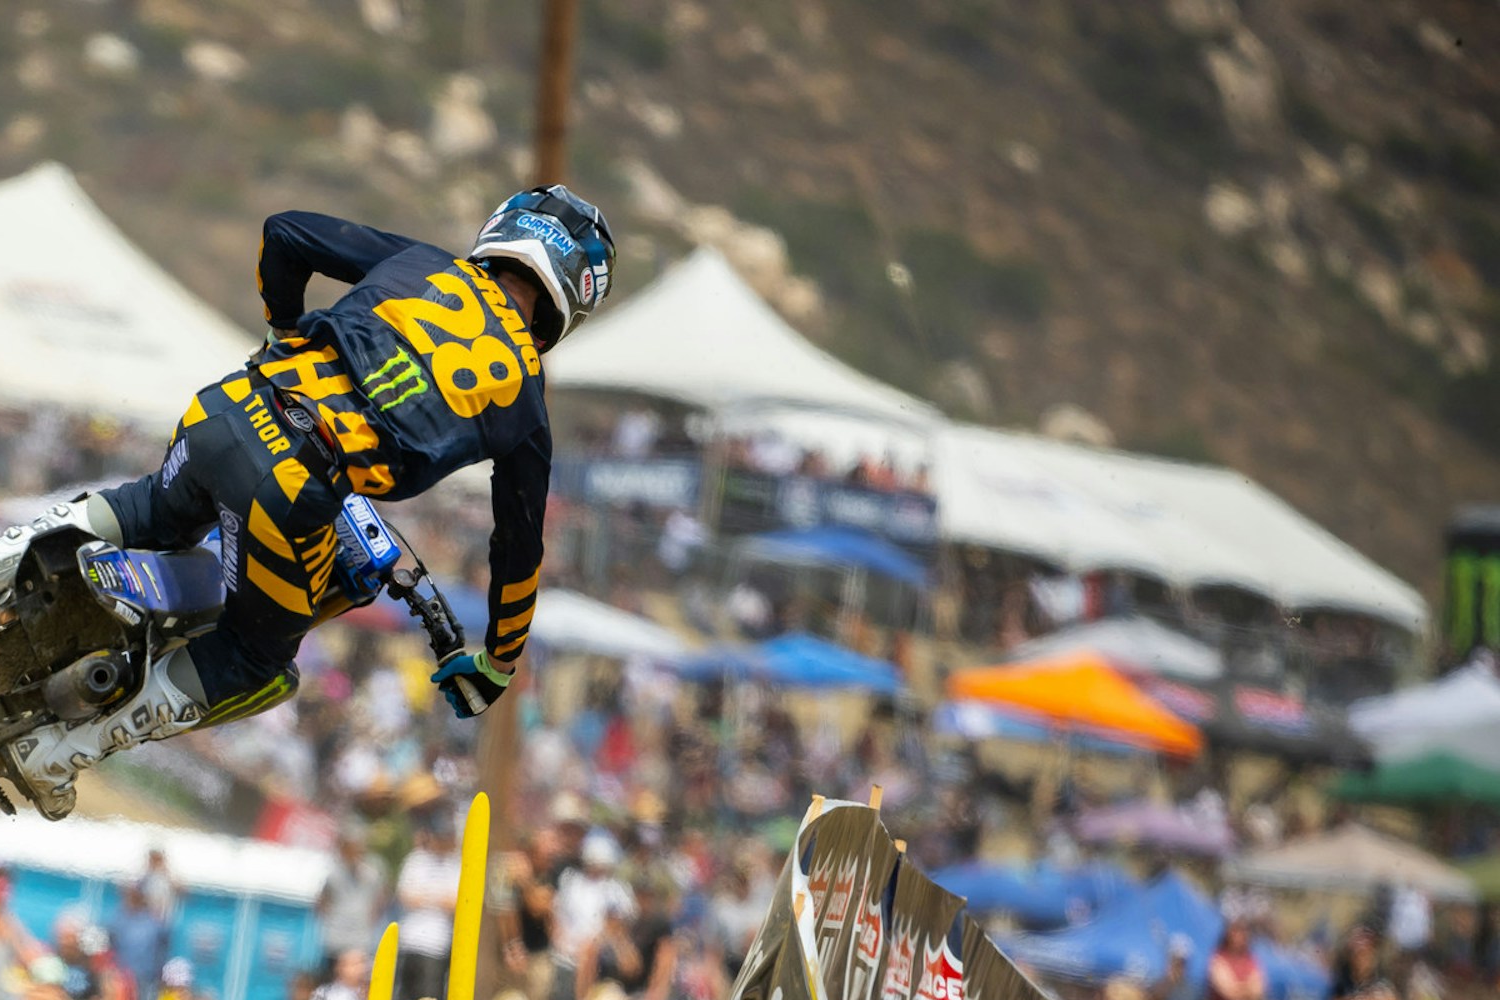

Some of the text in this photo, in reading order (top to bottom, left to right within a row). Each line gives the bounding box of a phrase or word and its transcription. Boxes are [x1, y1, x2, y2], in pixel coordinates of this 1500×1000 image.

[516, 215, 576, 256] CHRISTIAN
[582, 273, 591, 300] BELL
[372, 272, 524, 418] 28
[453, 258, 541, 377] CRAIG
[244, 393, 291, 455] THOR
[349, 497, 386, 557] PROTER
